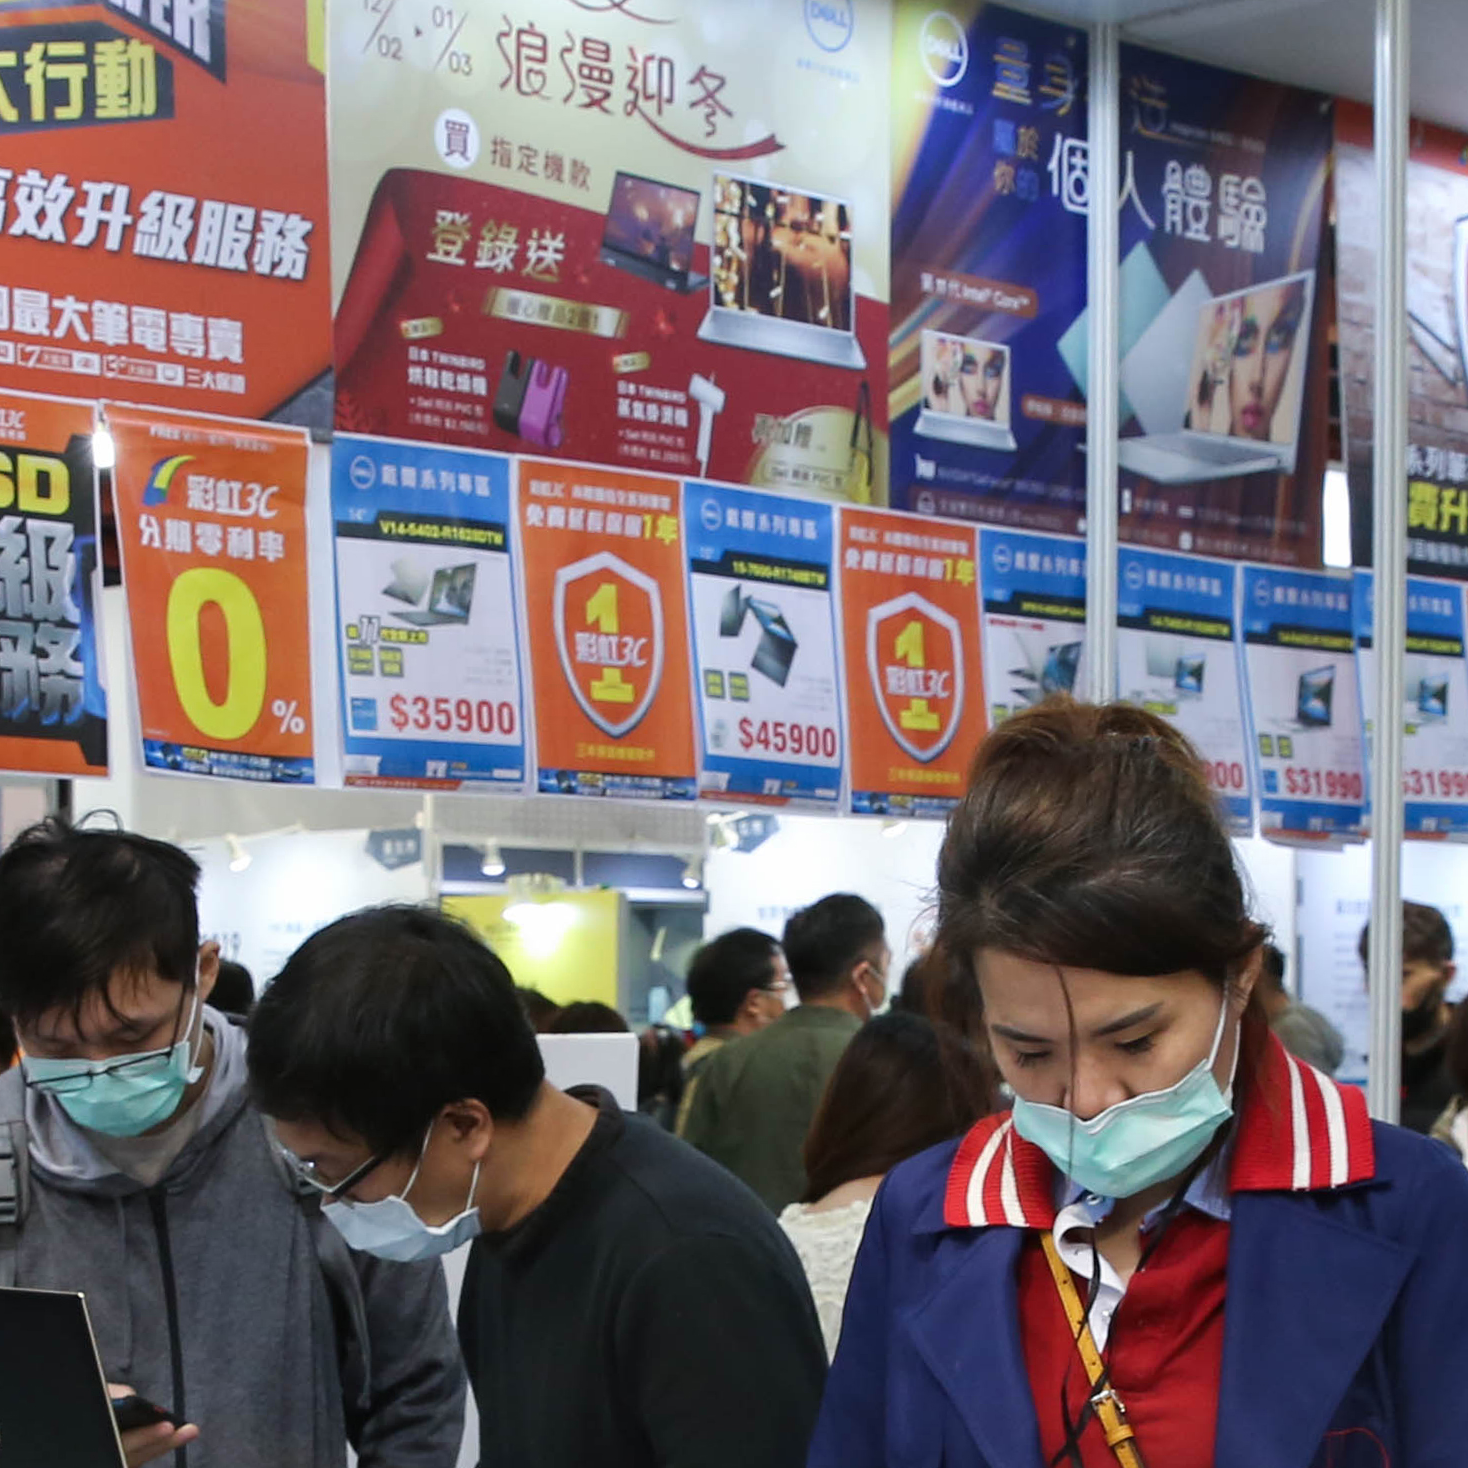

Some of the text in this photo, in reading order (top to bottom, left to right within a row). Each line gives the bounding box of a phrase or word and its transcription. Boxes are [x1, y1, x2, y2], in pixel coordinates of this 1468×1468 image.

[496, 14, 736, 140] 浪漫迎冬
[445, 119, 590, 191] 買 指定機款
[1048, 131, 1268, 254] 個人體驗
[427, 210, 565, 283] 登錄送
[187, 474, 279, 519] 彩虹3C
[138, 513, 285, 561] 分期零利率
[575, 631, 649, 667] 彩虹3C
[886, 664, 950, 699] 彩虹3C
[390, 694, 514, 735] $35900
[738, 717, 835, 757] $45900
[1285, 766, 1361, 799] $31990
